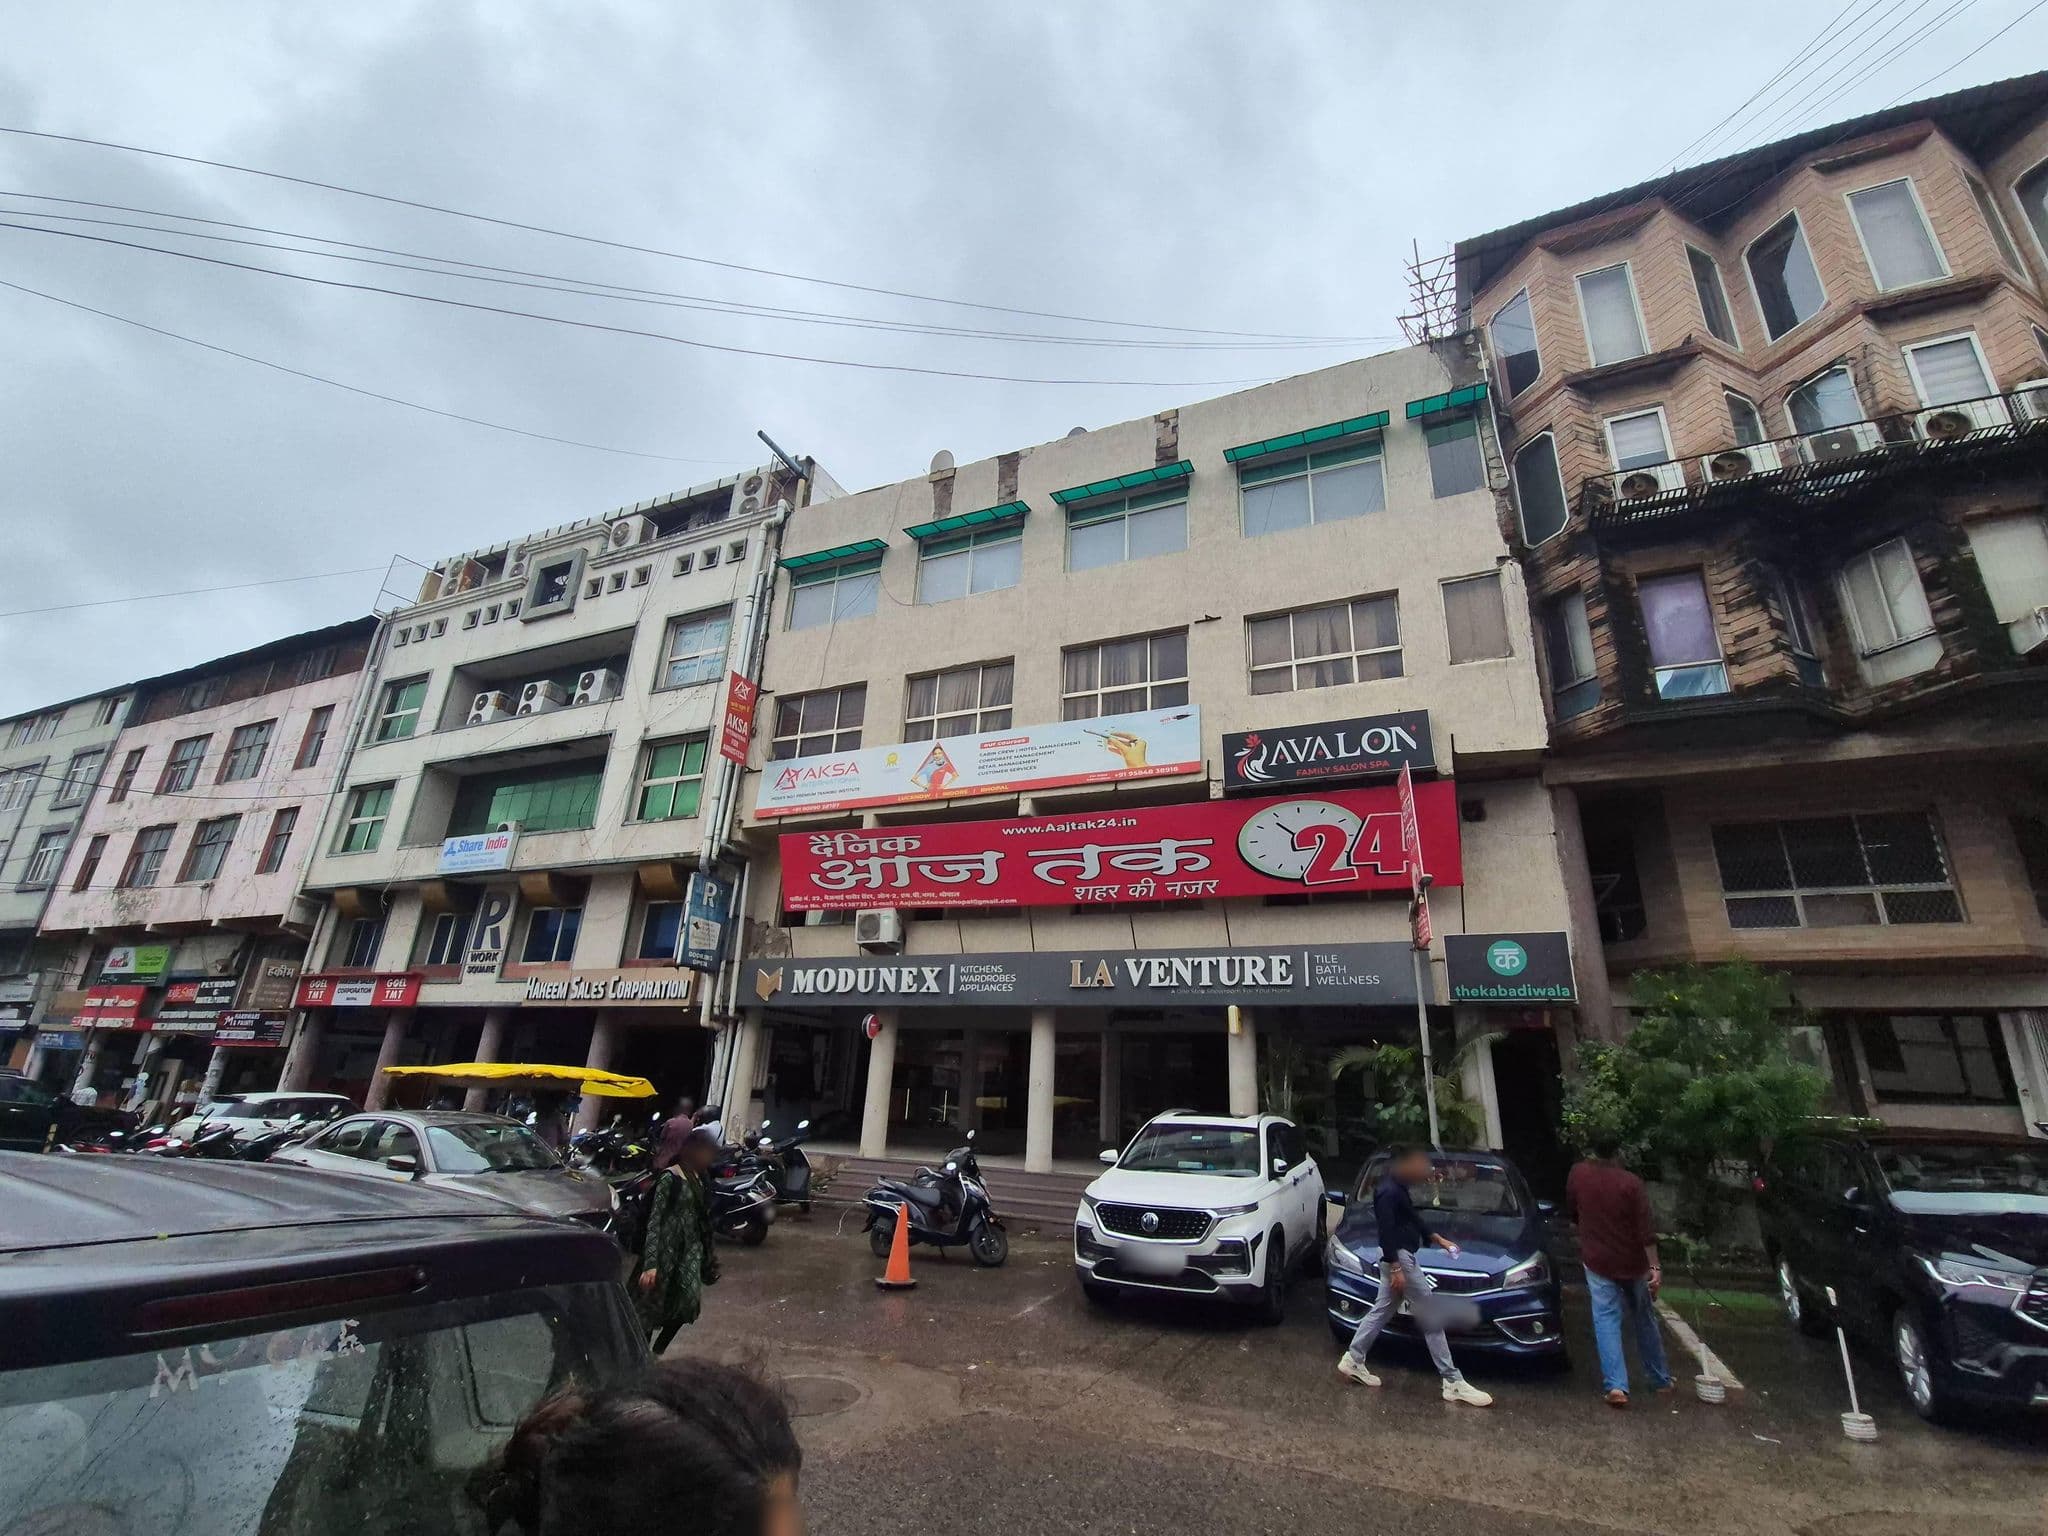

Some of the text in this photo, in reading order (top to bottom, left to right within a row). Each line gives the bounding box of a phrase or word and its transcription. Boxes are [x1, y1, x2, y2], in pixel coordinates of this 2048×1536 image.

[727, 712, 748, 736] AKSA
[1039, 740, 1081, 750] MANAGEMENT
[1268, 726, 1417, 766] AVALON
[1013, 750, 1056, 759] MANAGEMENT
[998, 759, 1040, 768] MANAGEMENT
[1296, 760, 1390, 777] FAMILY SALON SPA
[803, 762, 860, 781] AKSA
[1002, 817, 1137, 836] www.Aajtak24.in
[458, 836, 508, 853] Share India
[808, 834, 921, 859] दैनिक
[1292, 812, 1409, 886] 24
[810, 838, 1213, 890] आज तक
[1073, 877, 1220, 901] शहर की नज़र
[470, 951, 499, 963] WORK
[1314, 954, 1338, 964] TILE
[466, 965, 496, 974] SQUARE
[960, 964, 1003, 974] KITCHENS
[1124, 955, 1294, 988] VENTURE
[1315, 965, 1347, 974] BATH
[309, 980, 328, 988] GOEL
[386, 978, 407, 988] GOEL
[791, 966, 943, 994] MODUNEX
[959, 974, 1017, 983] WARDROBES
[1315, 975, 1380, 985] WELLNESS
[608, 975, 690, 1000] CORPORATION
[959, 982, 1013, 992] APPLIANCES
[1455, 984, 1570, 998] thekabadiwala
[307, 990, 324, 999] TMT
[384, 990, 403, 999] TMT
